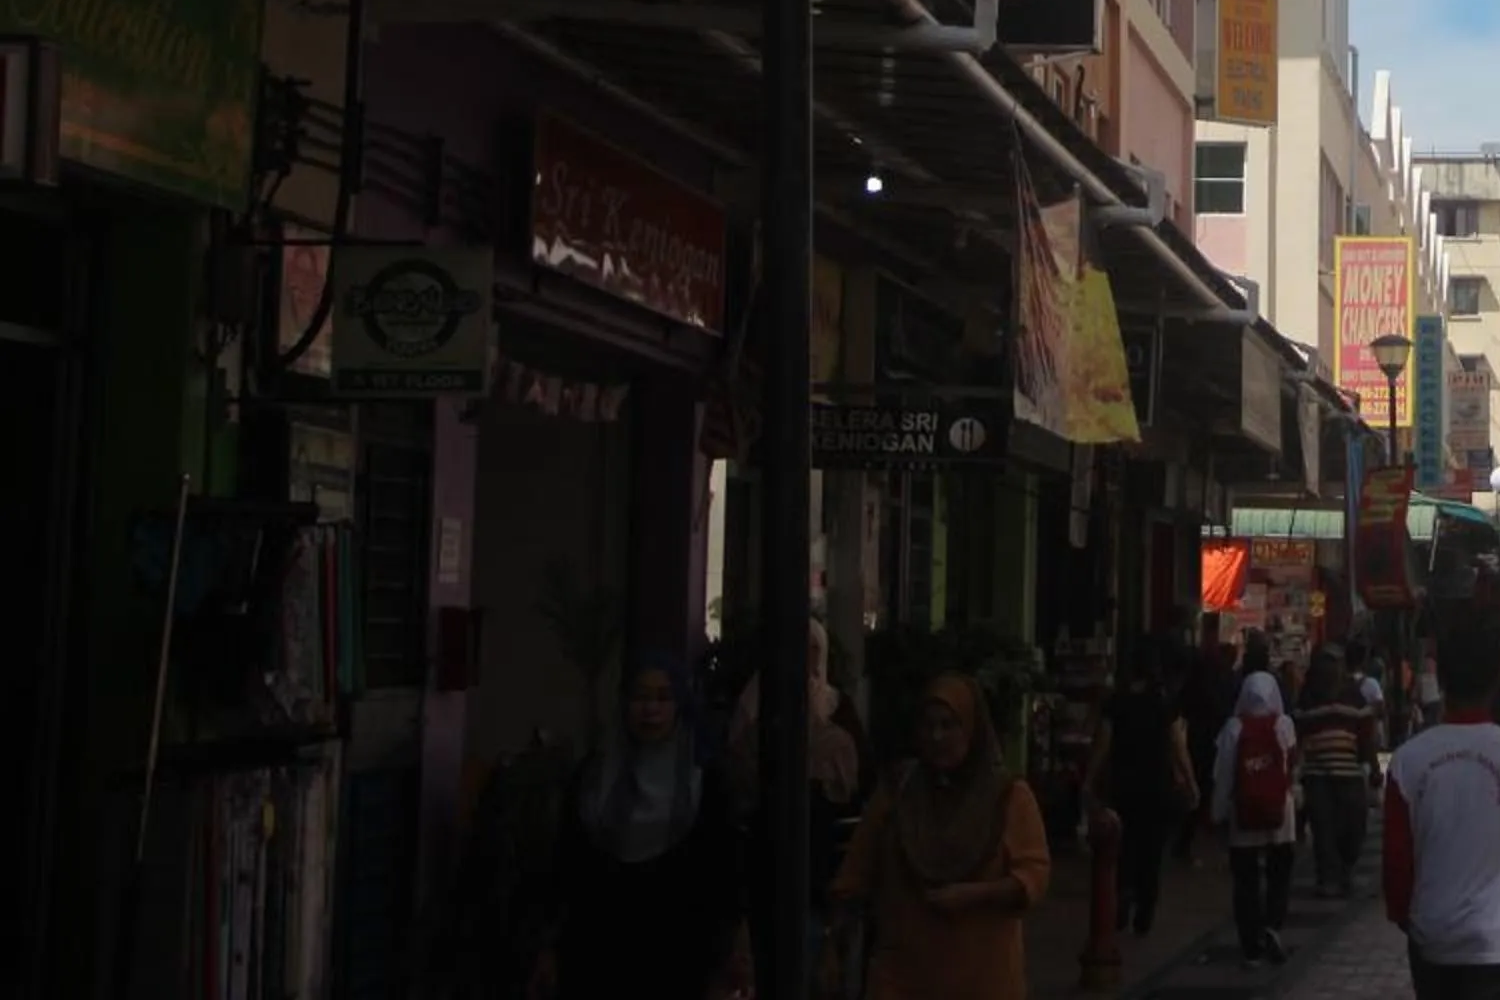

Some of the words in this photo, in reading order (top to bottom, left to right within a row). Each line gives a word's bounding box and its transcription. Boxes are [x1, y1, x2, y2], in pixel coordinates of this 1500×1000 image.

[541, 160, 596, 229] Sri
[1343, 263, 1405, 305] MONEY
[900, 410, 940, 433] SRI
